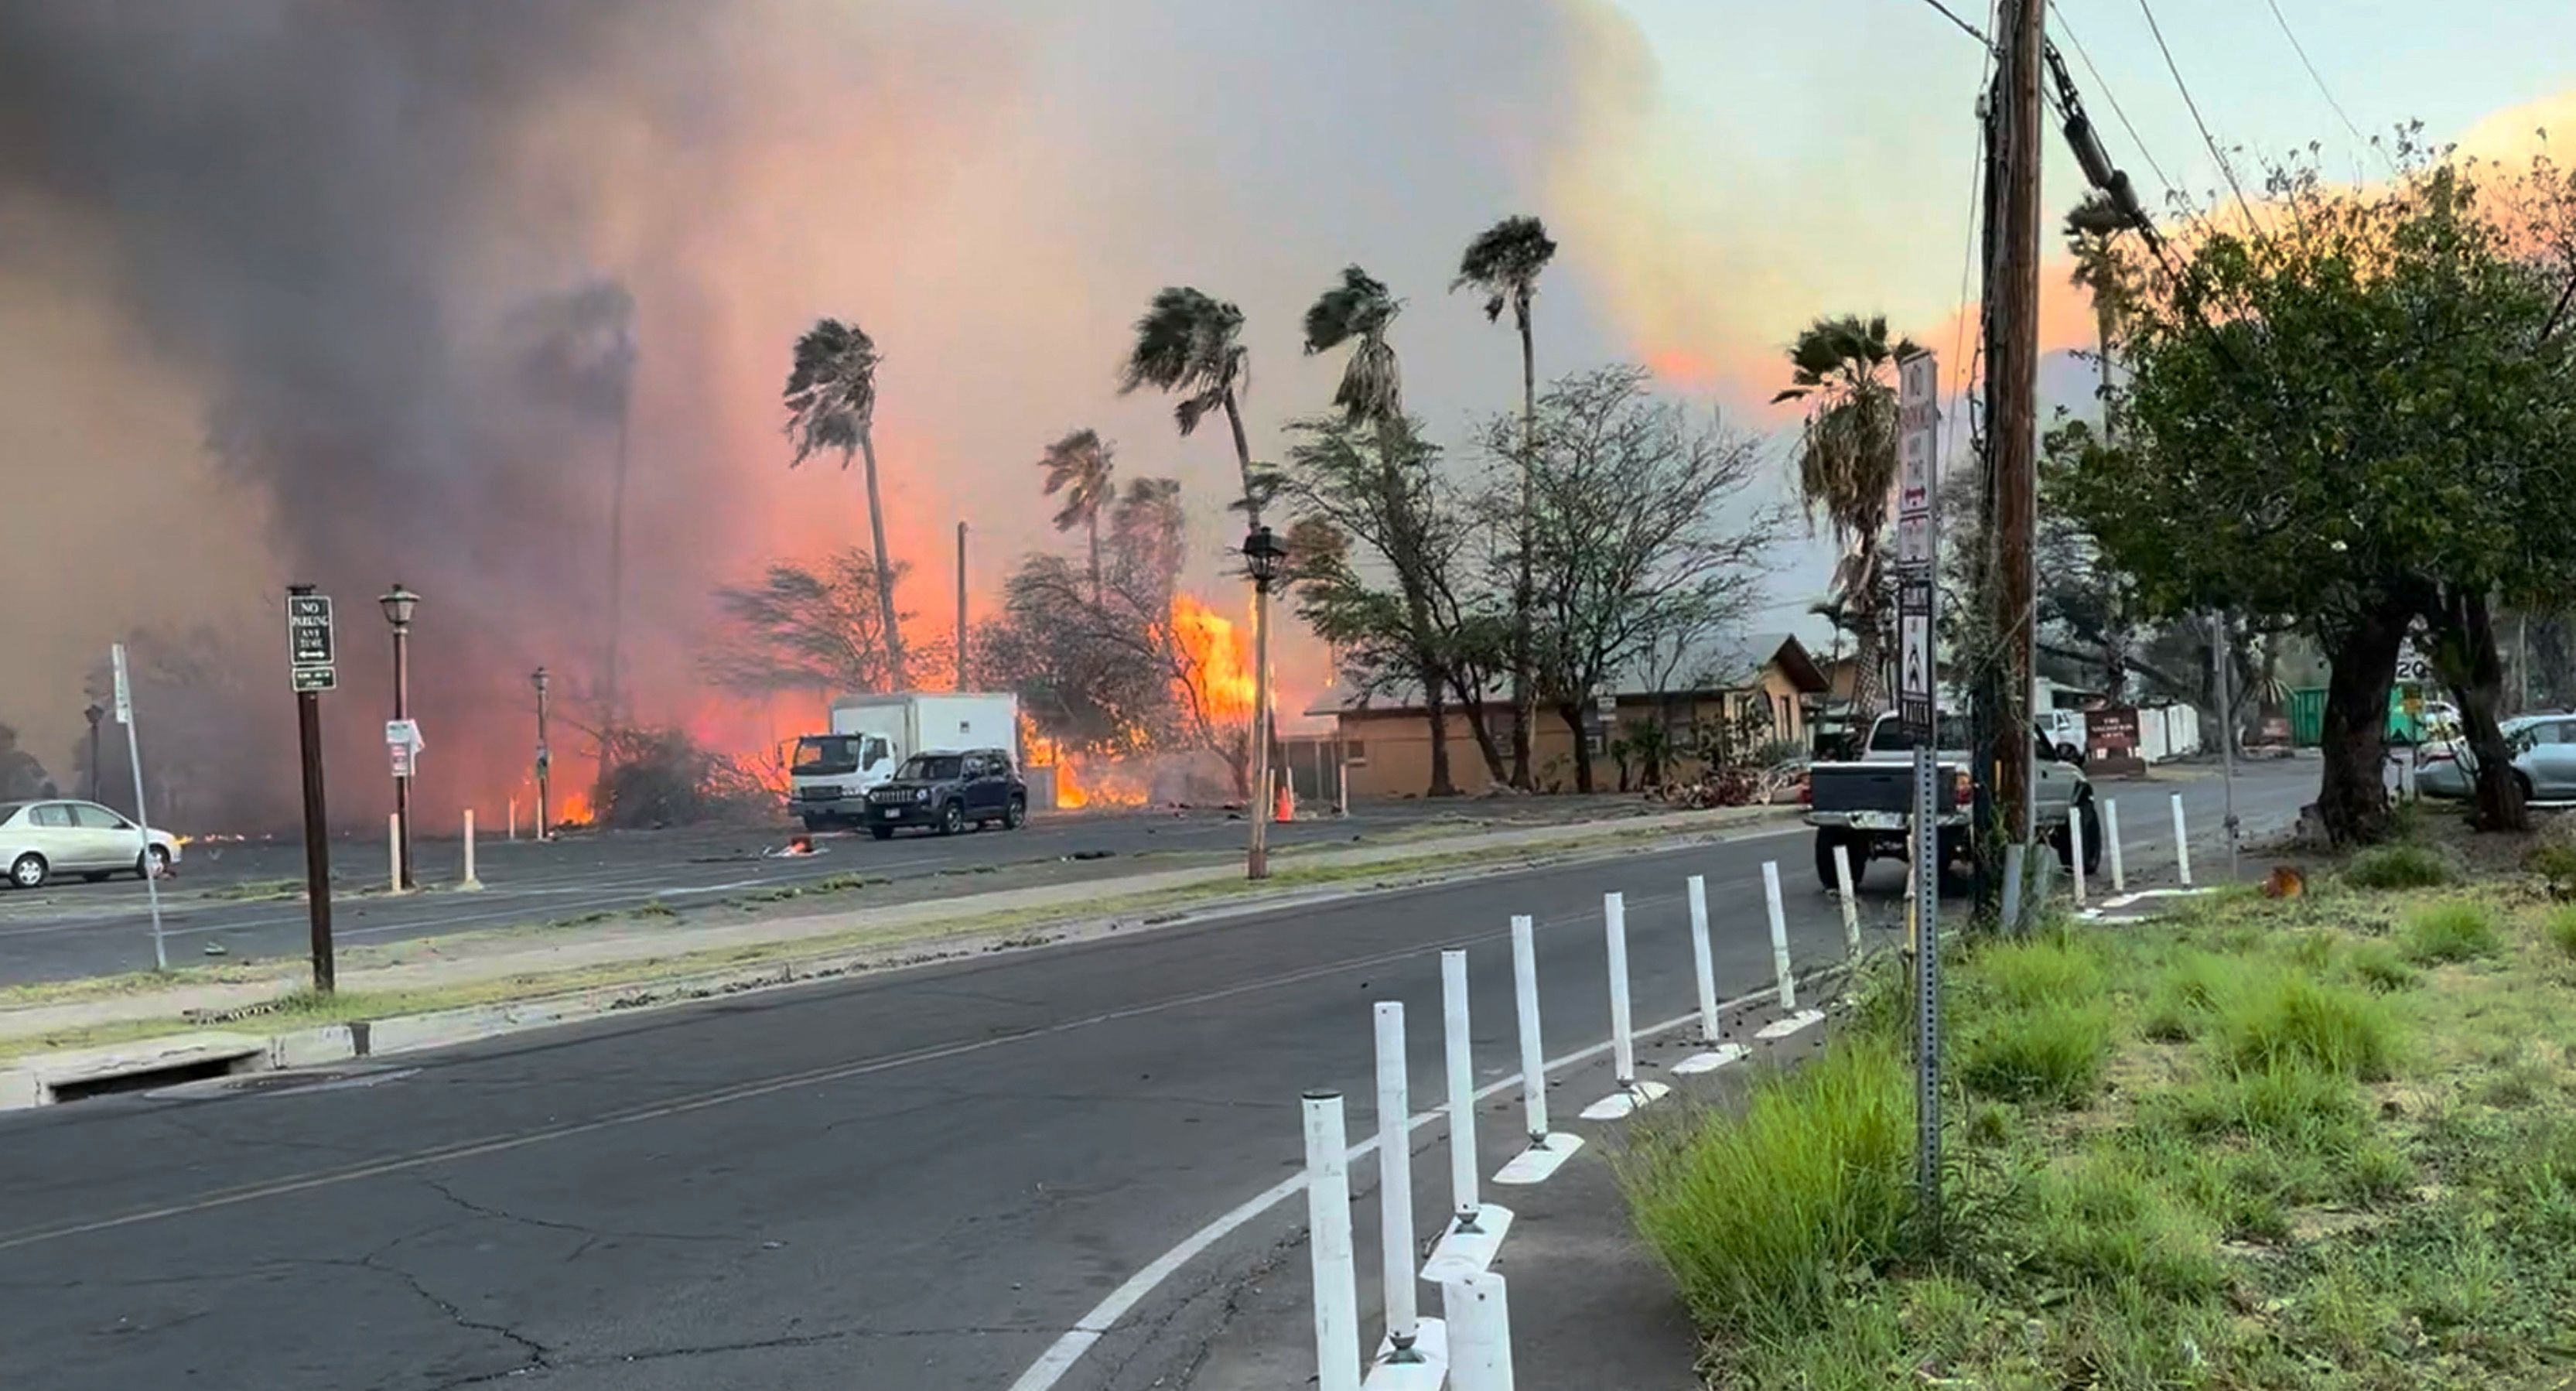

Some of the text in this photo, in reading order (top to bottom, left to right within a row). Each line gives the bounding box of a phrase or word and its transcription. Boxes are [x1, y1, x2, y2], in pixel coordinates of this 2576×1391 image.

[300, 602, 319, 613] NO
[292, 616, 329, 627] PARKING
[2397, 661, 2426, 678] 20
